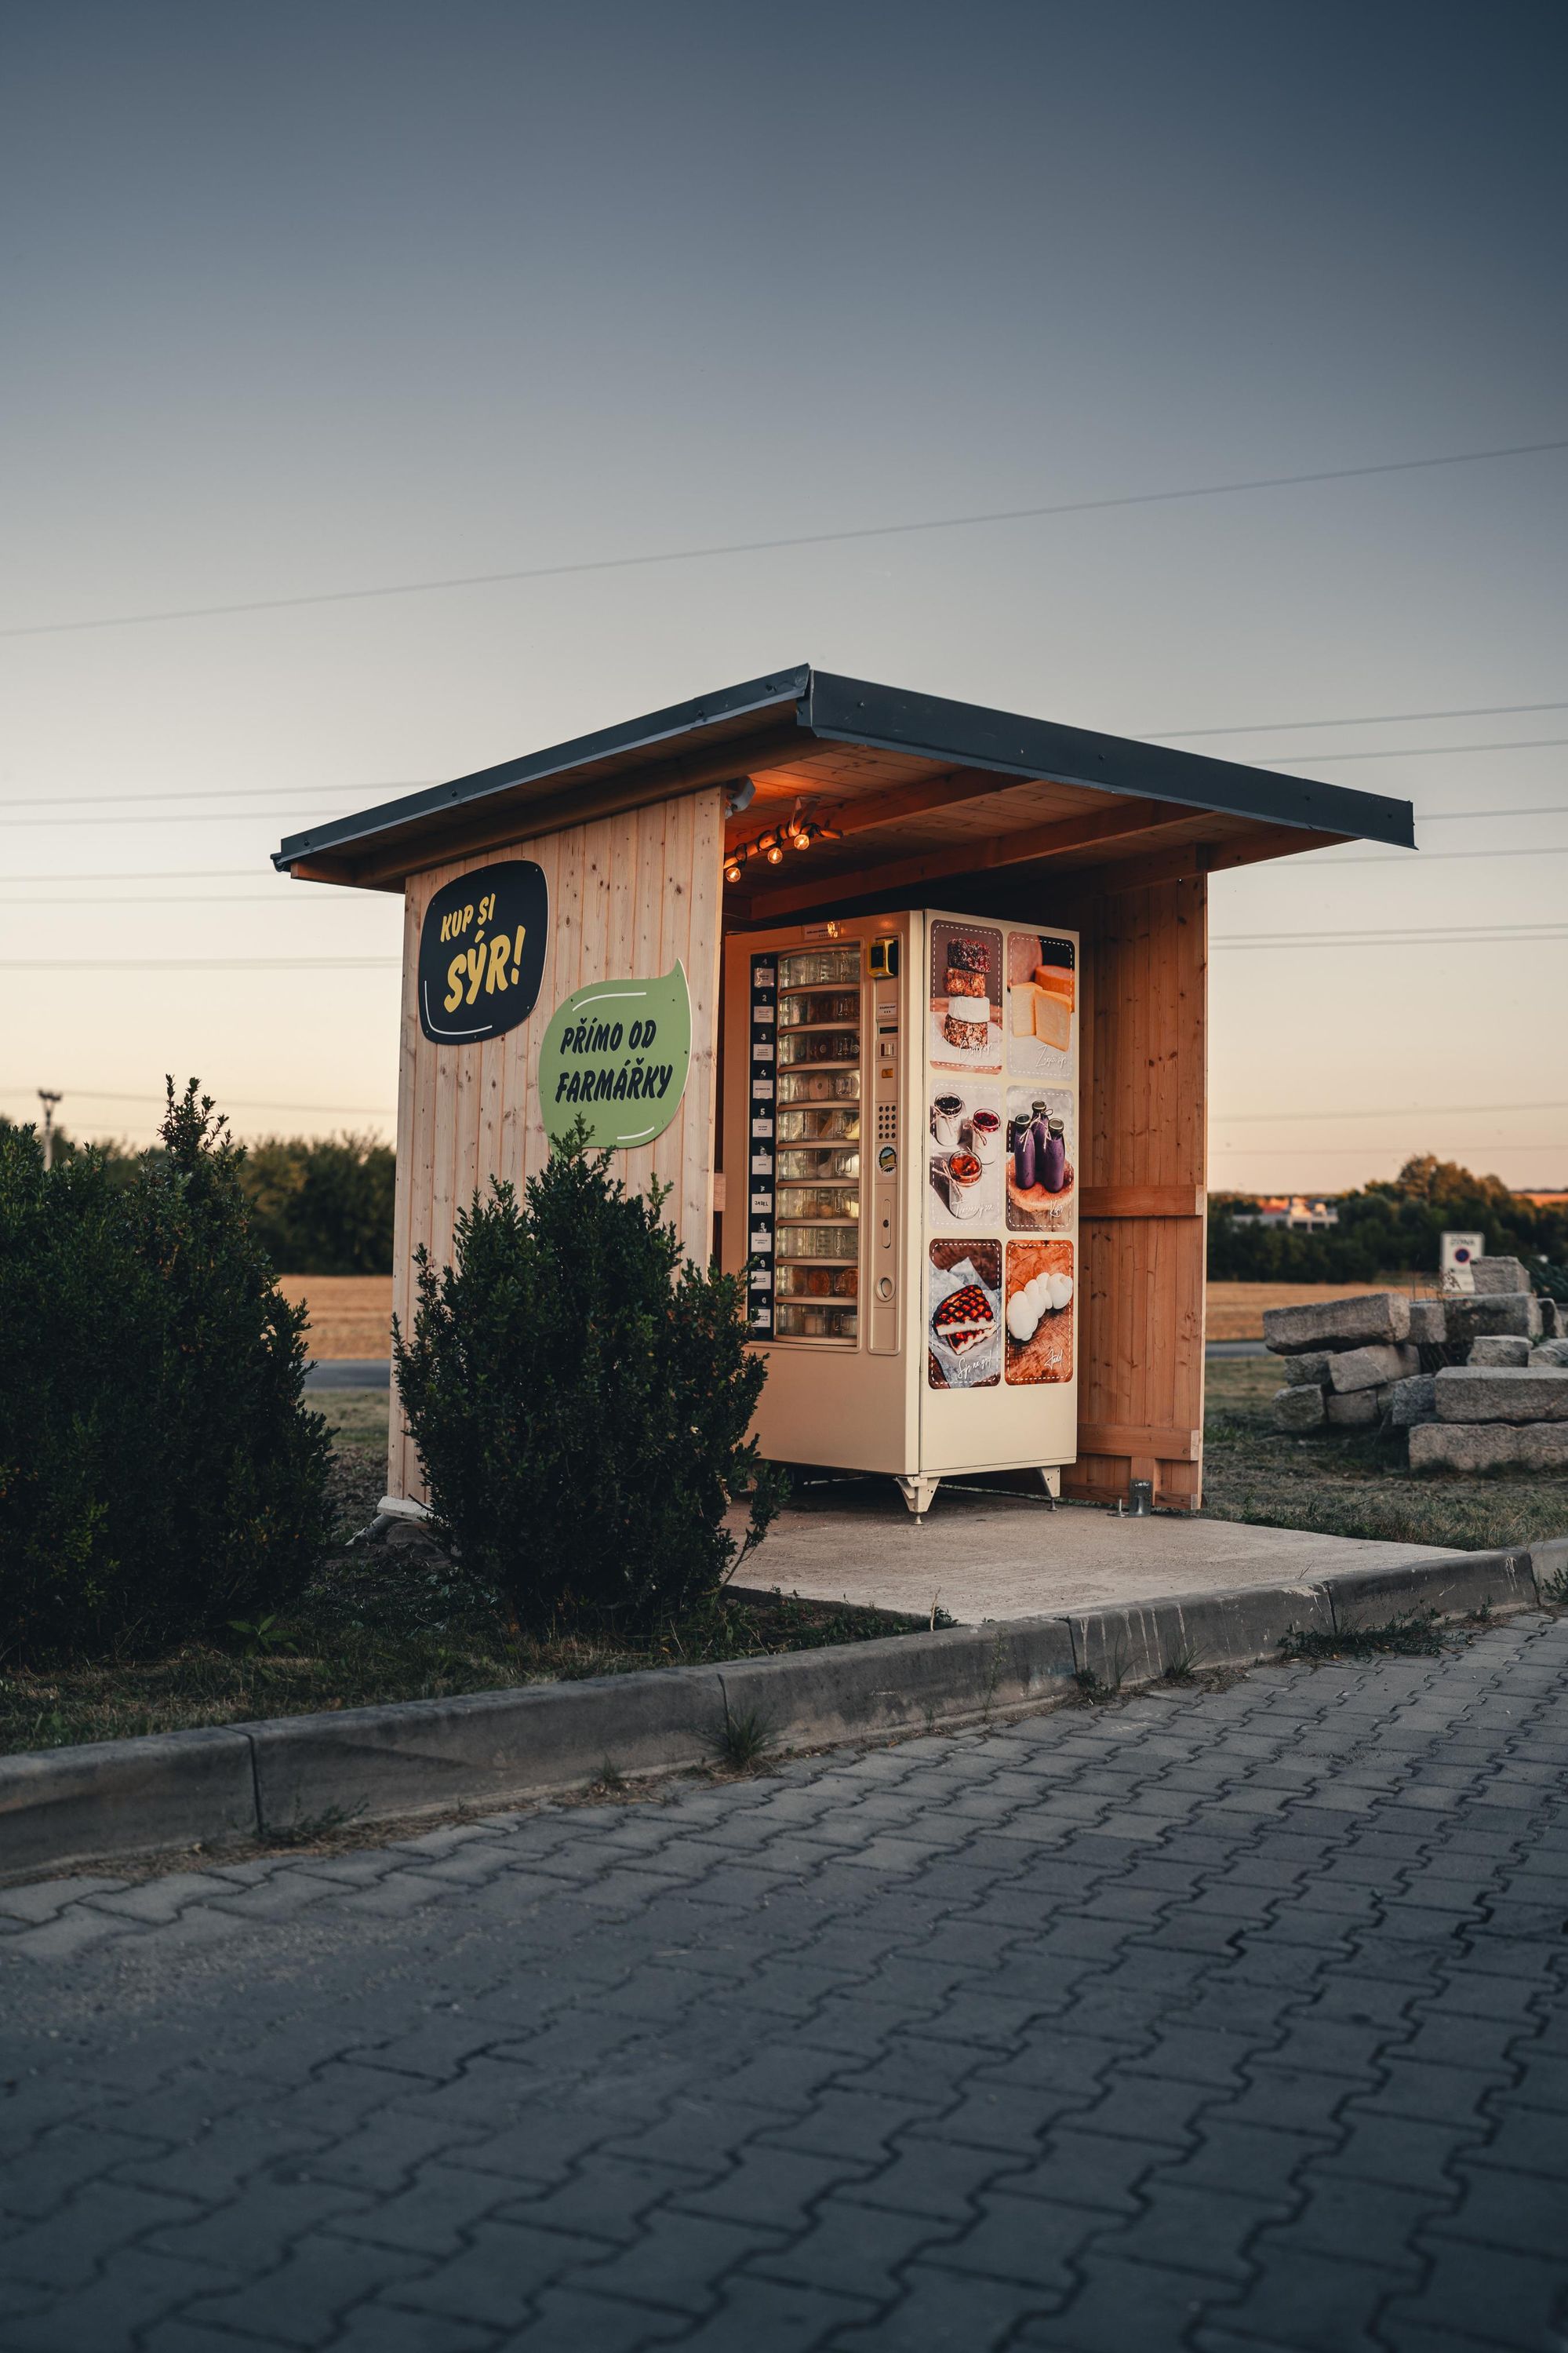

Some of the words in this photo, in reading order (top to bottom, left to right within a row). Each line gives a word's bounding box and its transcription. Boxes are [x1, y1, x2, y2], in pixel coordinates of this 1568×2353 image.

[440, 905, 474, 942] KUP
[477, 893, 496, 925] SI
[444, 925, 526, 1013] SÝR!
[560, 1017, 624, 1054] PŘÍMO
[628, 1020, 657, 1050] OD
[555, 1057, 674, 1103] FARMÁŘKY
